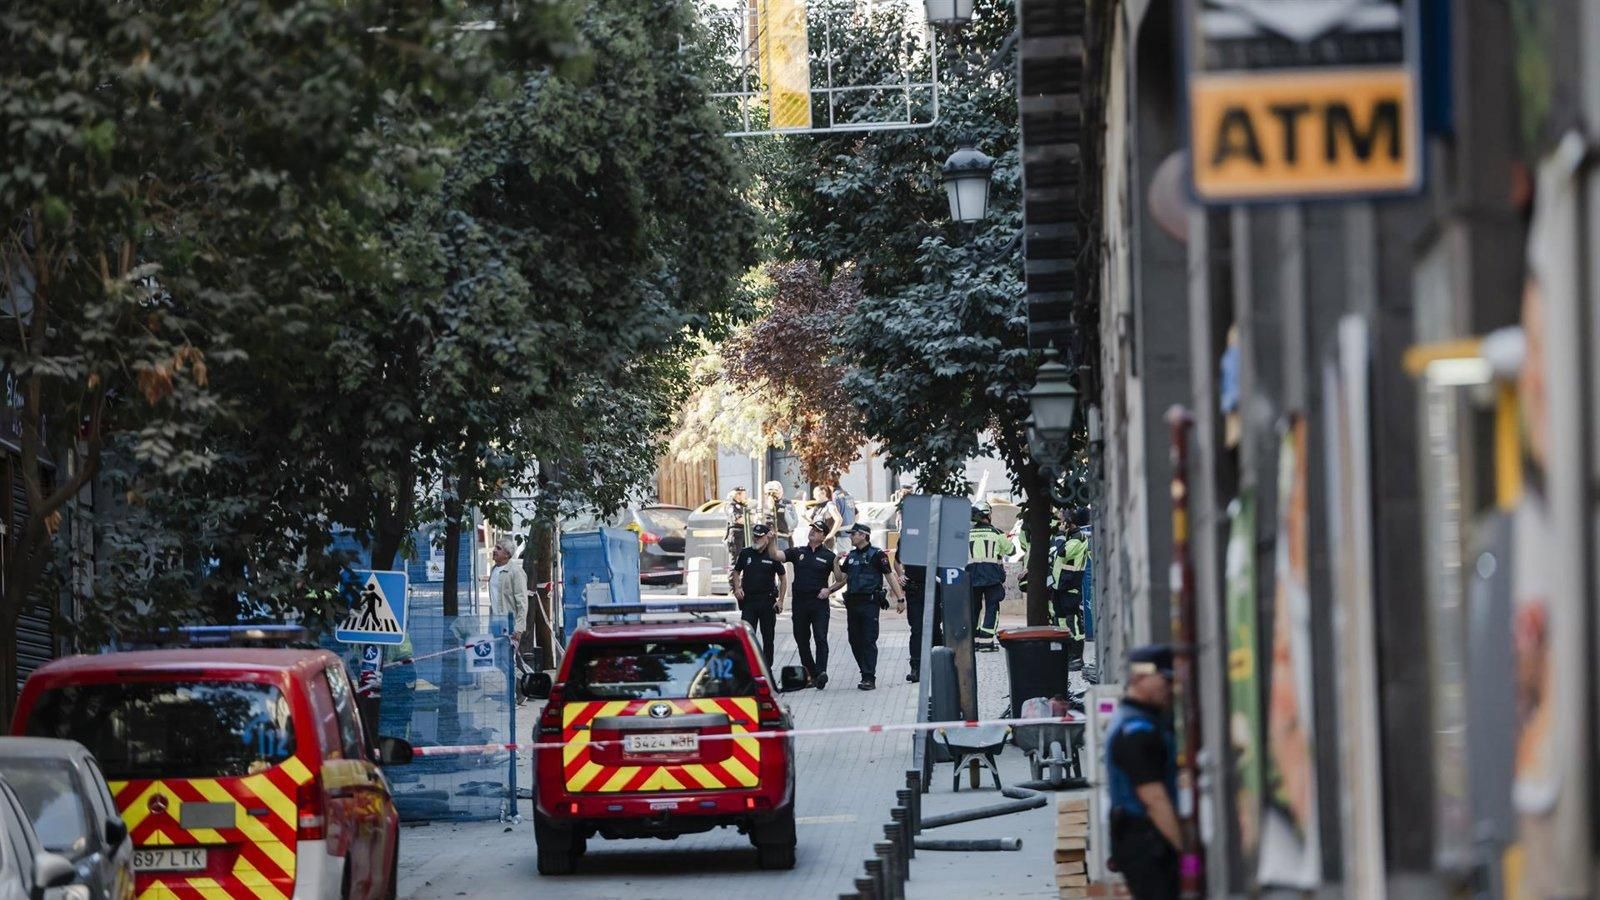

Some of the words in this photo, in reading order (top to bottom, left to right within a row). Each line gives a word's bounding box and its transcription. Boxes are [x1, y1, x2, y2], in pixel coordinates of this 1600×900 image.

[1211, 99, 1402, 168] ATM
[946, 568, 959, 585] P
[170, 850, 201, 867] LTK
